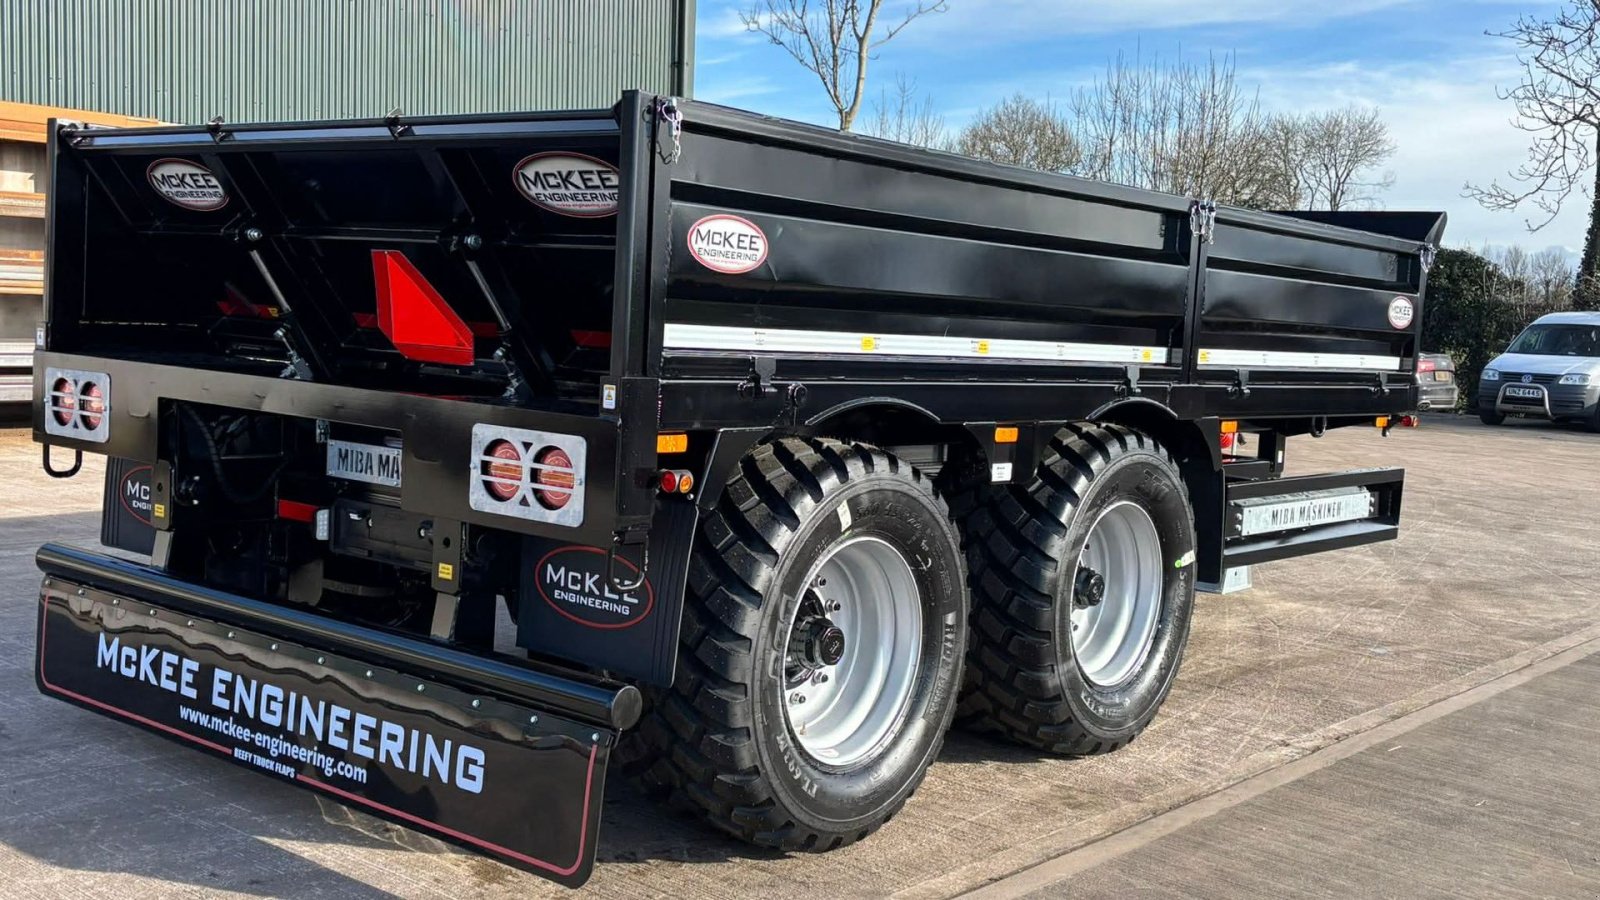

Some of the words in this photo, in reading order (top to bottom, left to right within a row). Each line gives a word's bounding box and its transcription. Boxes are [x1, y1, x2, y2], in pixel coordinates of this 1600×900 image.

[695, 228, 760, 251] McKEE
[698, 248, 758, 261] ENGINEERING
[337, 447, 374, 476] MIBA
[1271, 508, 1295, 526] MIBA
[554, 590, 630, 616] ENGINEERING
[97, 632, 199, 700] McKEE
[211, 667, 485, 794] ENGINEERING
[179, 704, 367, 784] www.mckee-engineering.com
[234, 747, 253, 763] BEEFY
[252, 754, 275, 771] TRUCK
[275, 762, 295, 778] FLAPS
